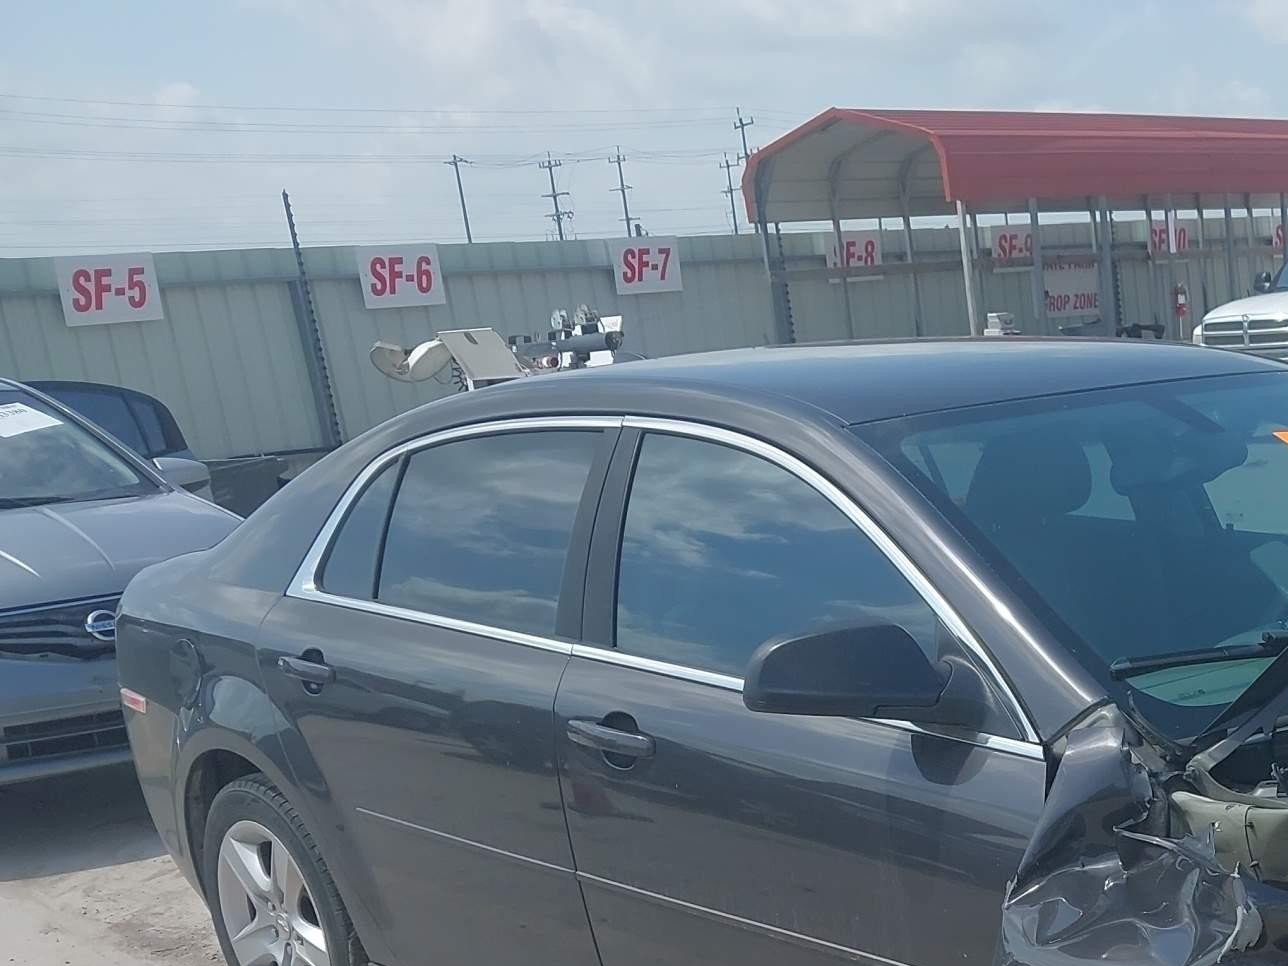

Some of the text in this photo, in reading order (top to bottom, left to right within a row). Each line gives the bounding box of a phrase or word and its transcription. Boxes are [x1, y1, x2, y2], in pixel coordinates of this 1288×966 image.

[623, 247, 671, 284] SF-7
[833, 240, 875, 267] F-8
[71, 266, 147, 313] SF-5
[370, 256, 433, 297] SF-6
[1047, 292, 1099, 312] ROP ZONE
